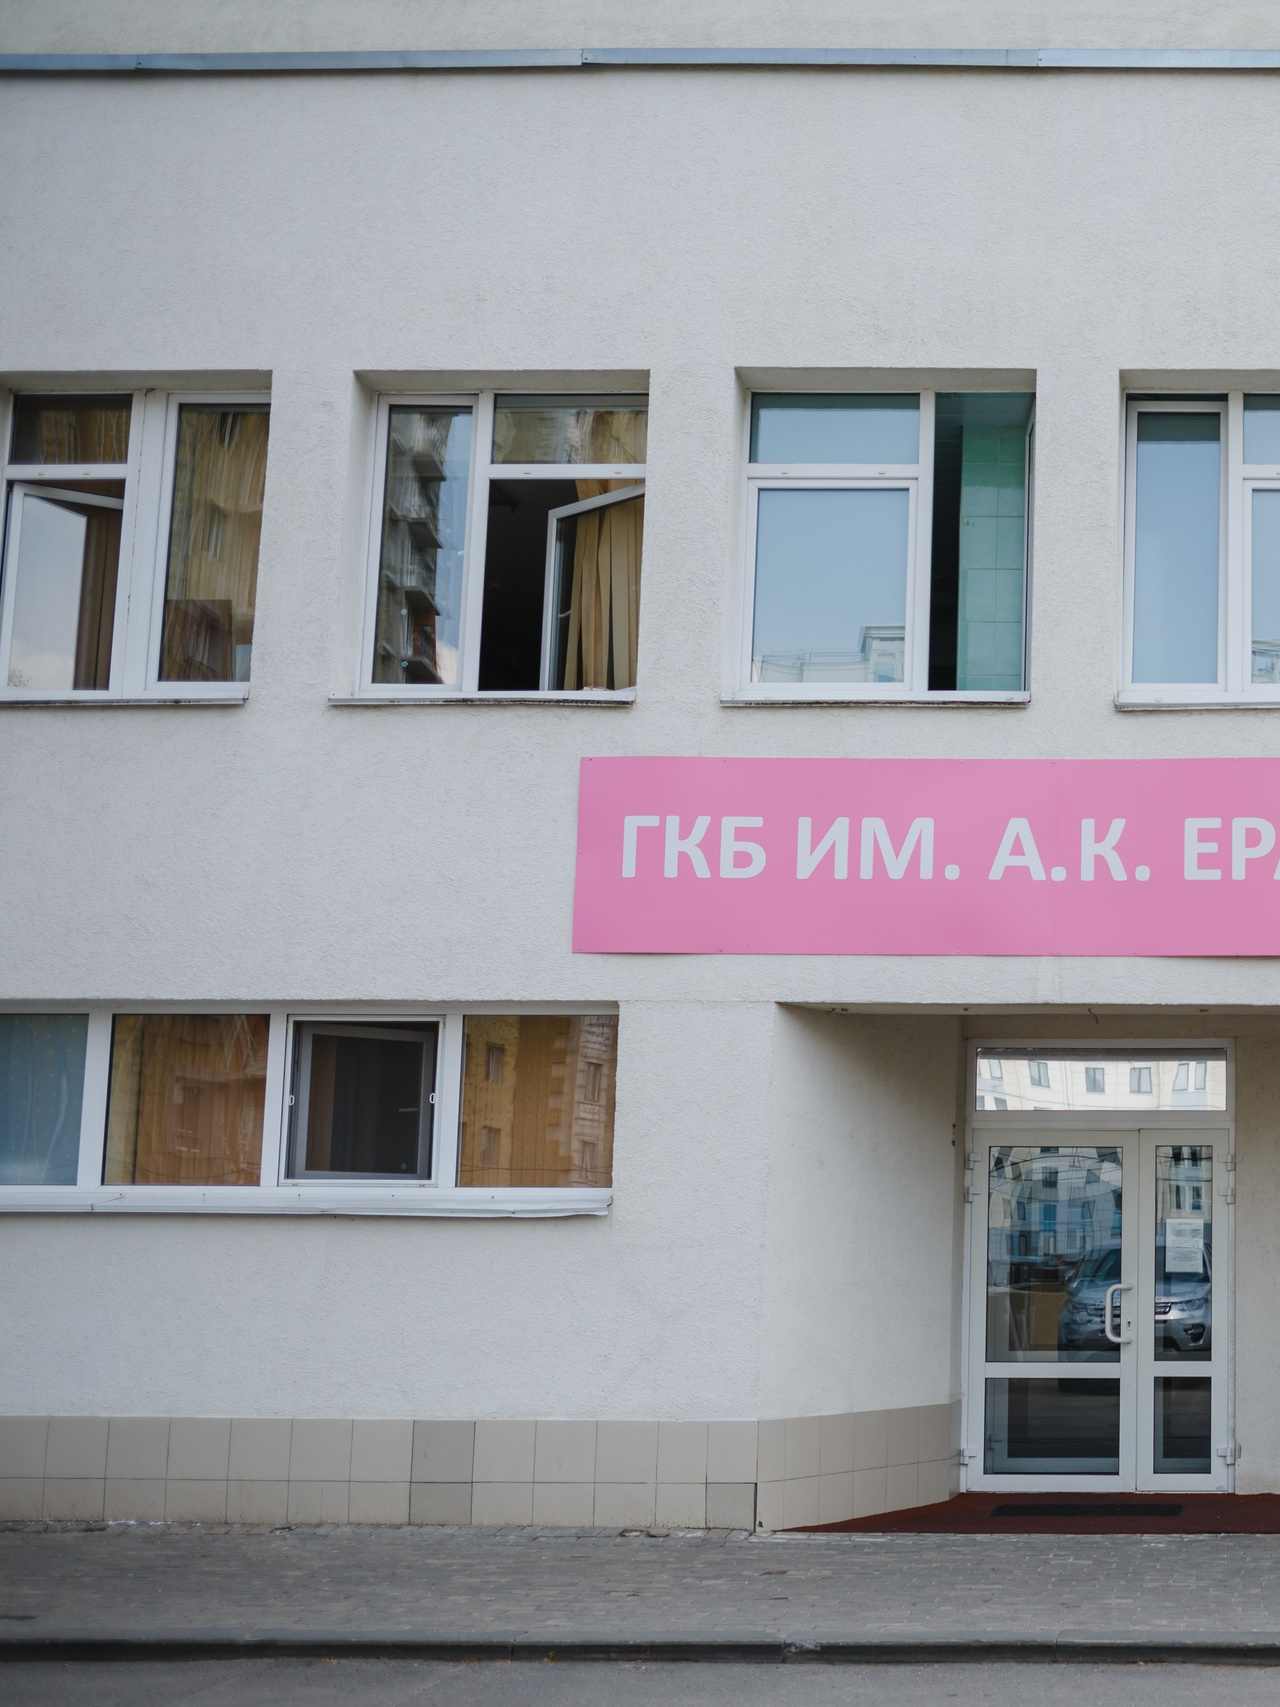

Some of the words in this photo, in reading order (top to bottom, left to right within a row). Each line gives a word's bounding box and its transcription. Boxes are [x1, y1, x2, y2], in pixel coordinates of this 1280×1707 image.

[621, 814, 767, 880] ГКБ
[796, 815, 961, 881] ИМ.
[987, 816, 1151, 882] А.К.
